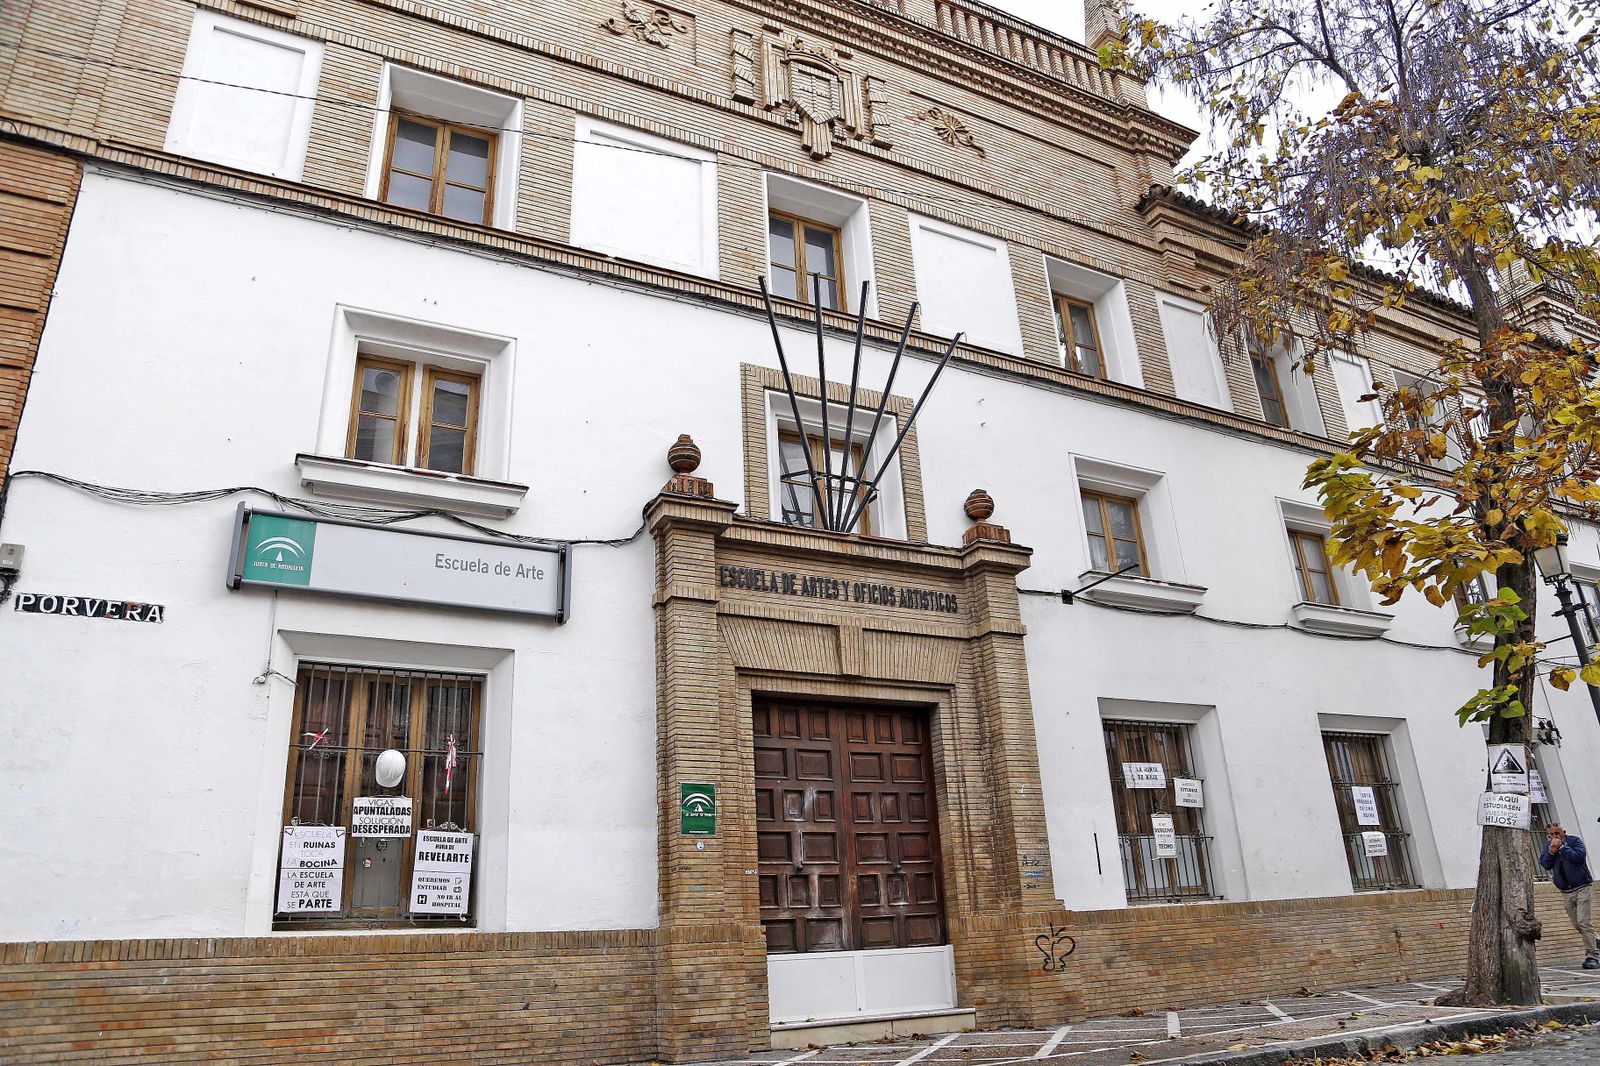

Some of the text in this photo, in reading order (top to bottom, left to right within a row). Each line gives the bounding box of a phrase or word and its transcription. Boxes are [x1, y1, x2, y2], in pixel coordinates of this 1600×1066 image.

[434, 553, 544, 580] Escuela de Arte
[720, 565, 958, 613] ESCUELA DE ARTES Y OFICIOS ARTISTICOS
[15, 594, 164, 623] PORVERA
[368, 799, 395, 807] VIGAS
[1483, 803, 1521, 811] ESTUDIASEN
[353, 806, 412, 816] APUNTALADAS
[359, 816, 404, 825] SOLUCIÓN
[1485, 816, 1517, 826] HIJOS?
[352, 825, 411, 834] DESESPERADA
[294, 830, 332, 839] ESCUELA
[423, 835, 447, 843] ESCUELA
[303, 841, 336, 849] RUINAS
[418, 851, 470, 863] REVELARTE
[299, 859, 338, 868] BOCINA
[299, 871, 334, 879] ESCUELA
[291, 890, 309, 898] ESTÁ
[287, 899, 333, 909] SE PARTE
